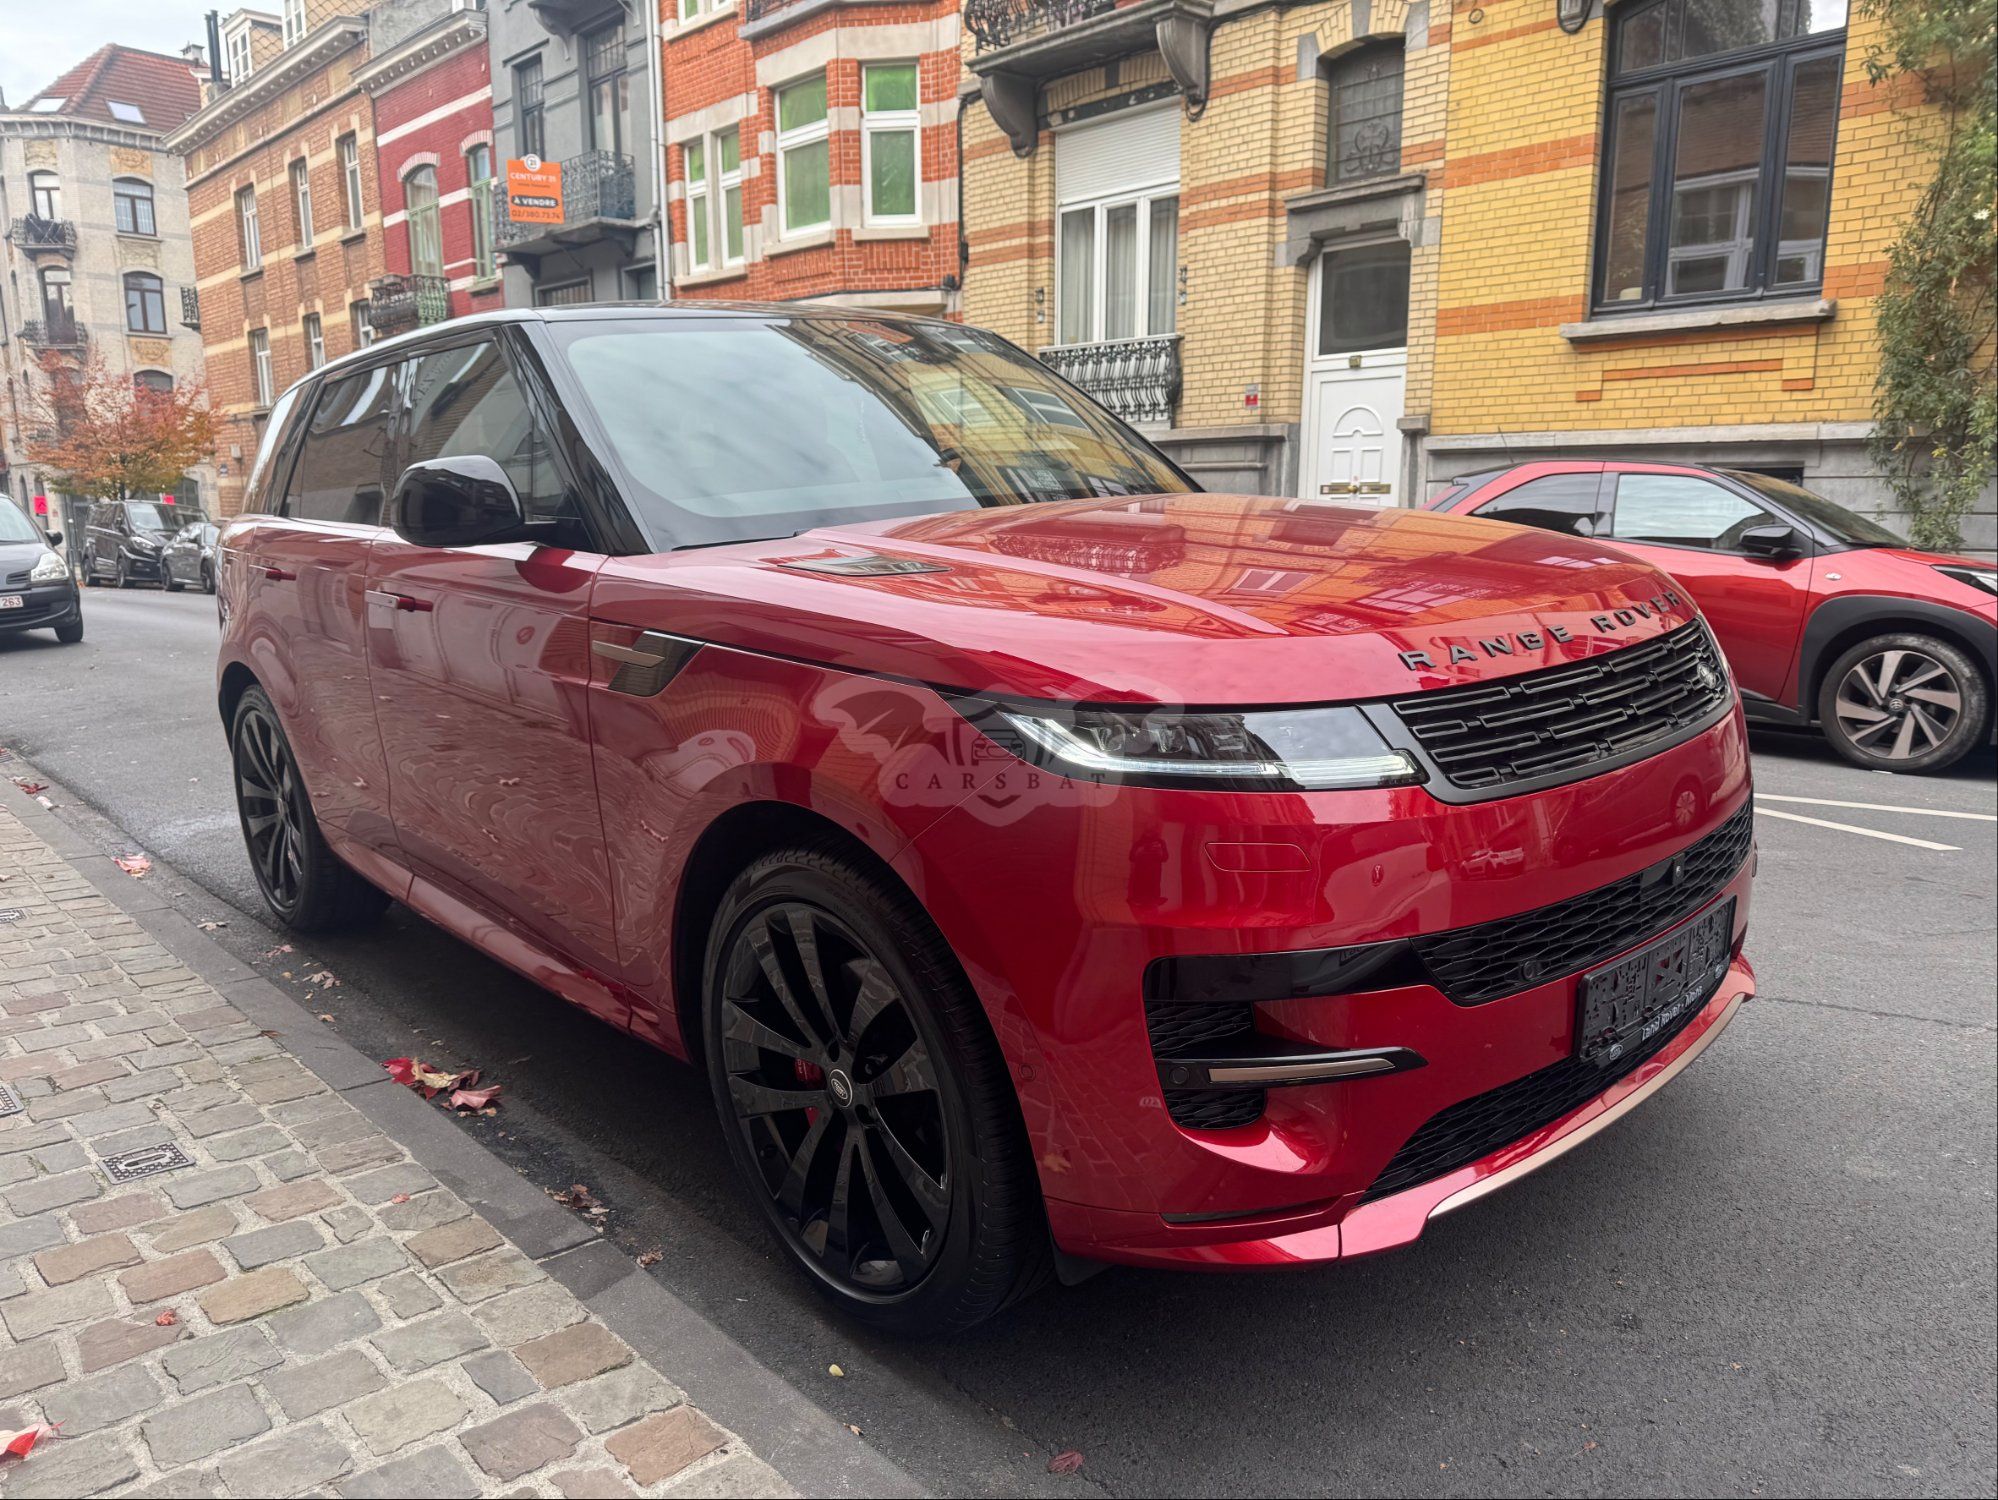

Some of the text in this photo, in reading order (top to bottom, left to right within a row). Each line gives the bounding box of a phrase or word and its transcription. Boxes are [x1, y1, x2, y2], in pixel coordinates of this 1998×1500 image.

[510, 171, 546, 182] CENTURY
[521, 198, 556, 207] VENDRE
[1398, 589, 1683, 671] RANGE ROVER
[1641, 1015, 1660, 1041] Land
[1660, 1003, 1681, 1027] Rover
